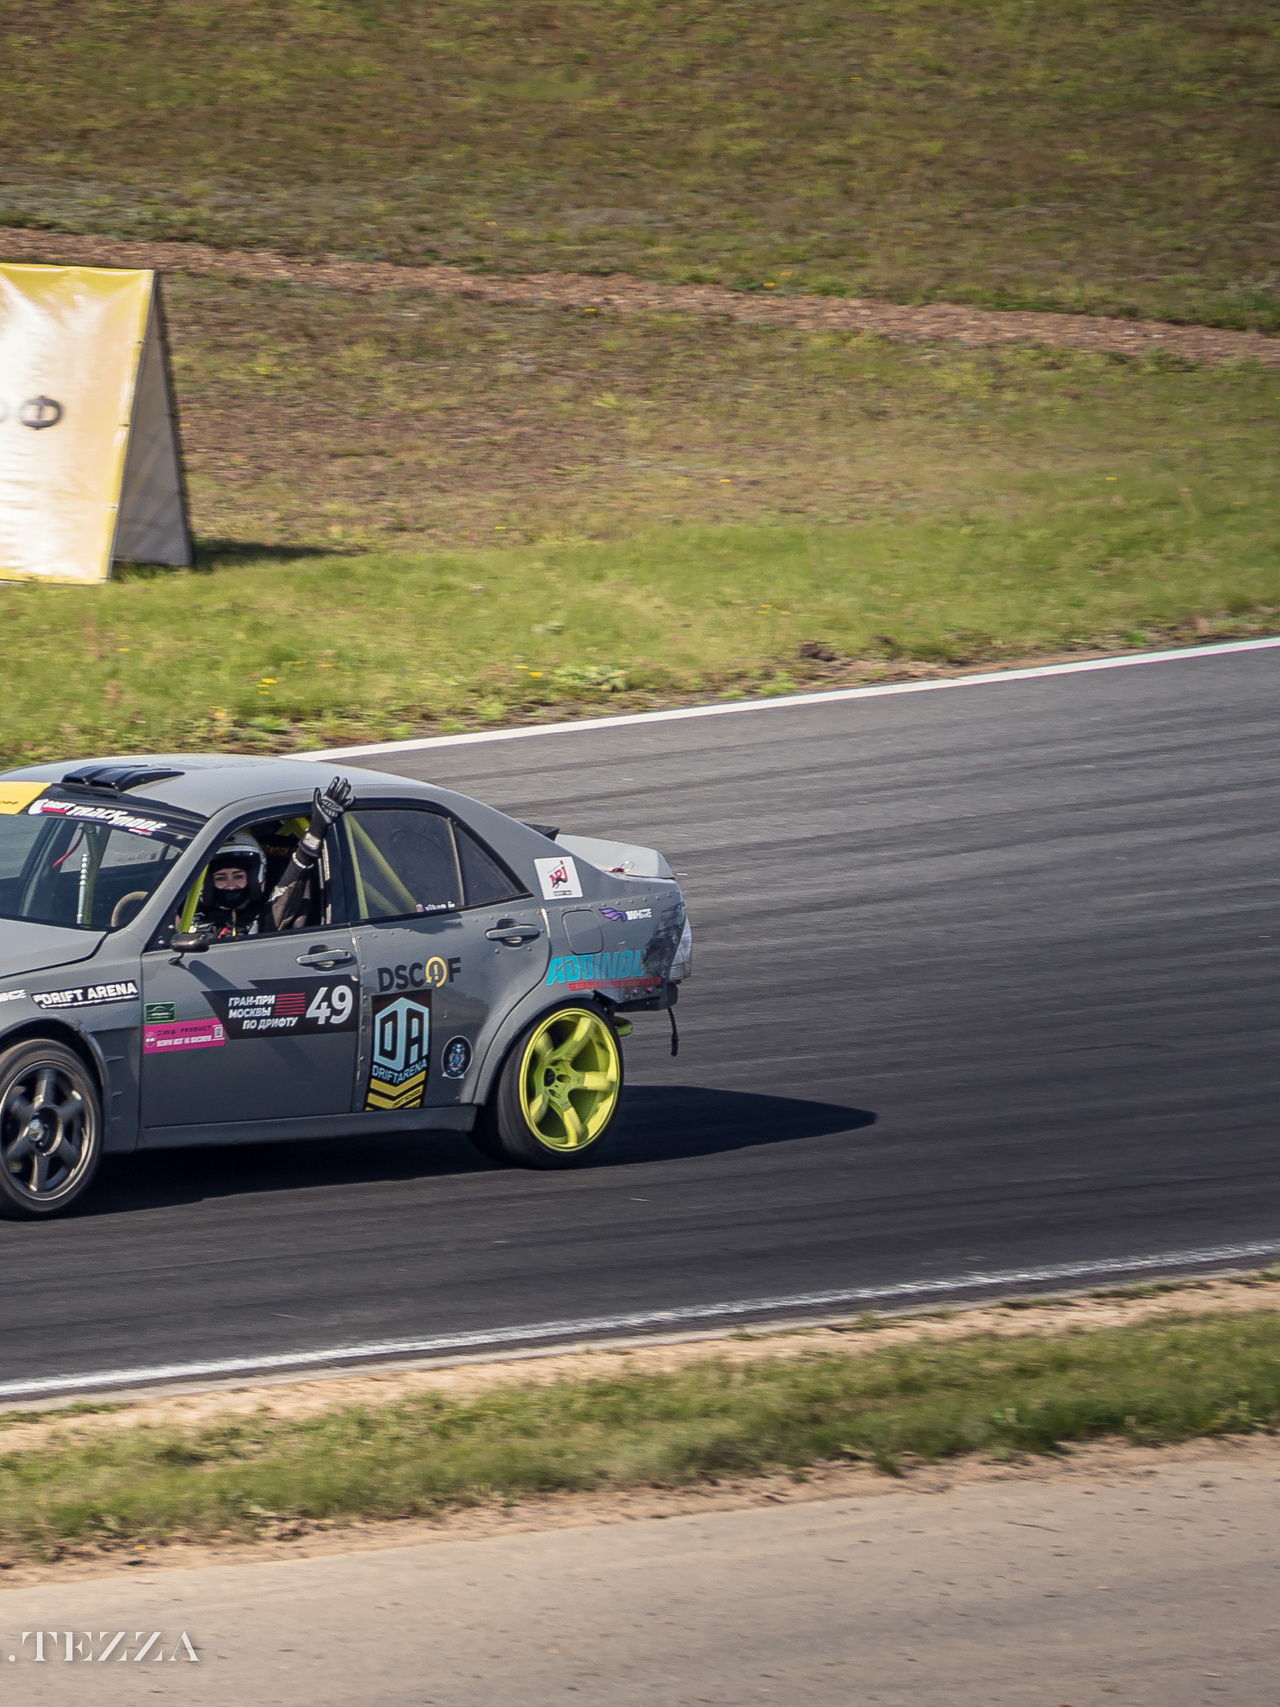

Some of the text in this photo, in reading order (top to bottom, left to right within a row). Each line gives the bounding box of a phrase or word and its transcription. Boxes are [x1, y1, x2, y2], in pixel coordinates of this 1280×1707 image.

[86, 982, 138, 1000] ARENA
[228, 994, 276, 1008] ГРАН-ПРИ
[305, 984, 354, 1025] 49
[228, 1006, 271, 1019] МОСКВЫ
[242, 1016, 299, 1031] ПО ДРИФТУ
